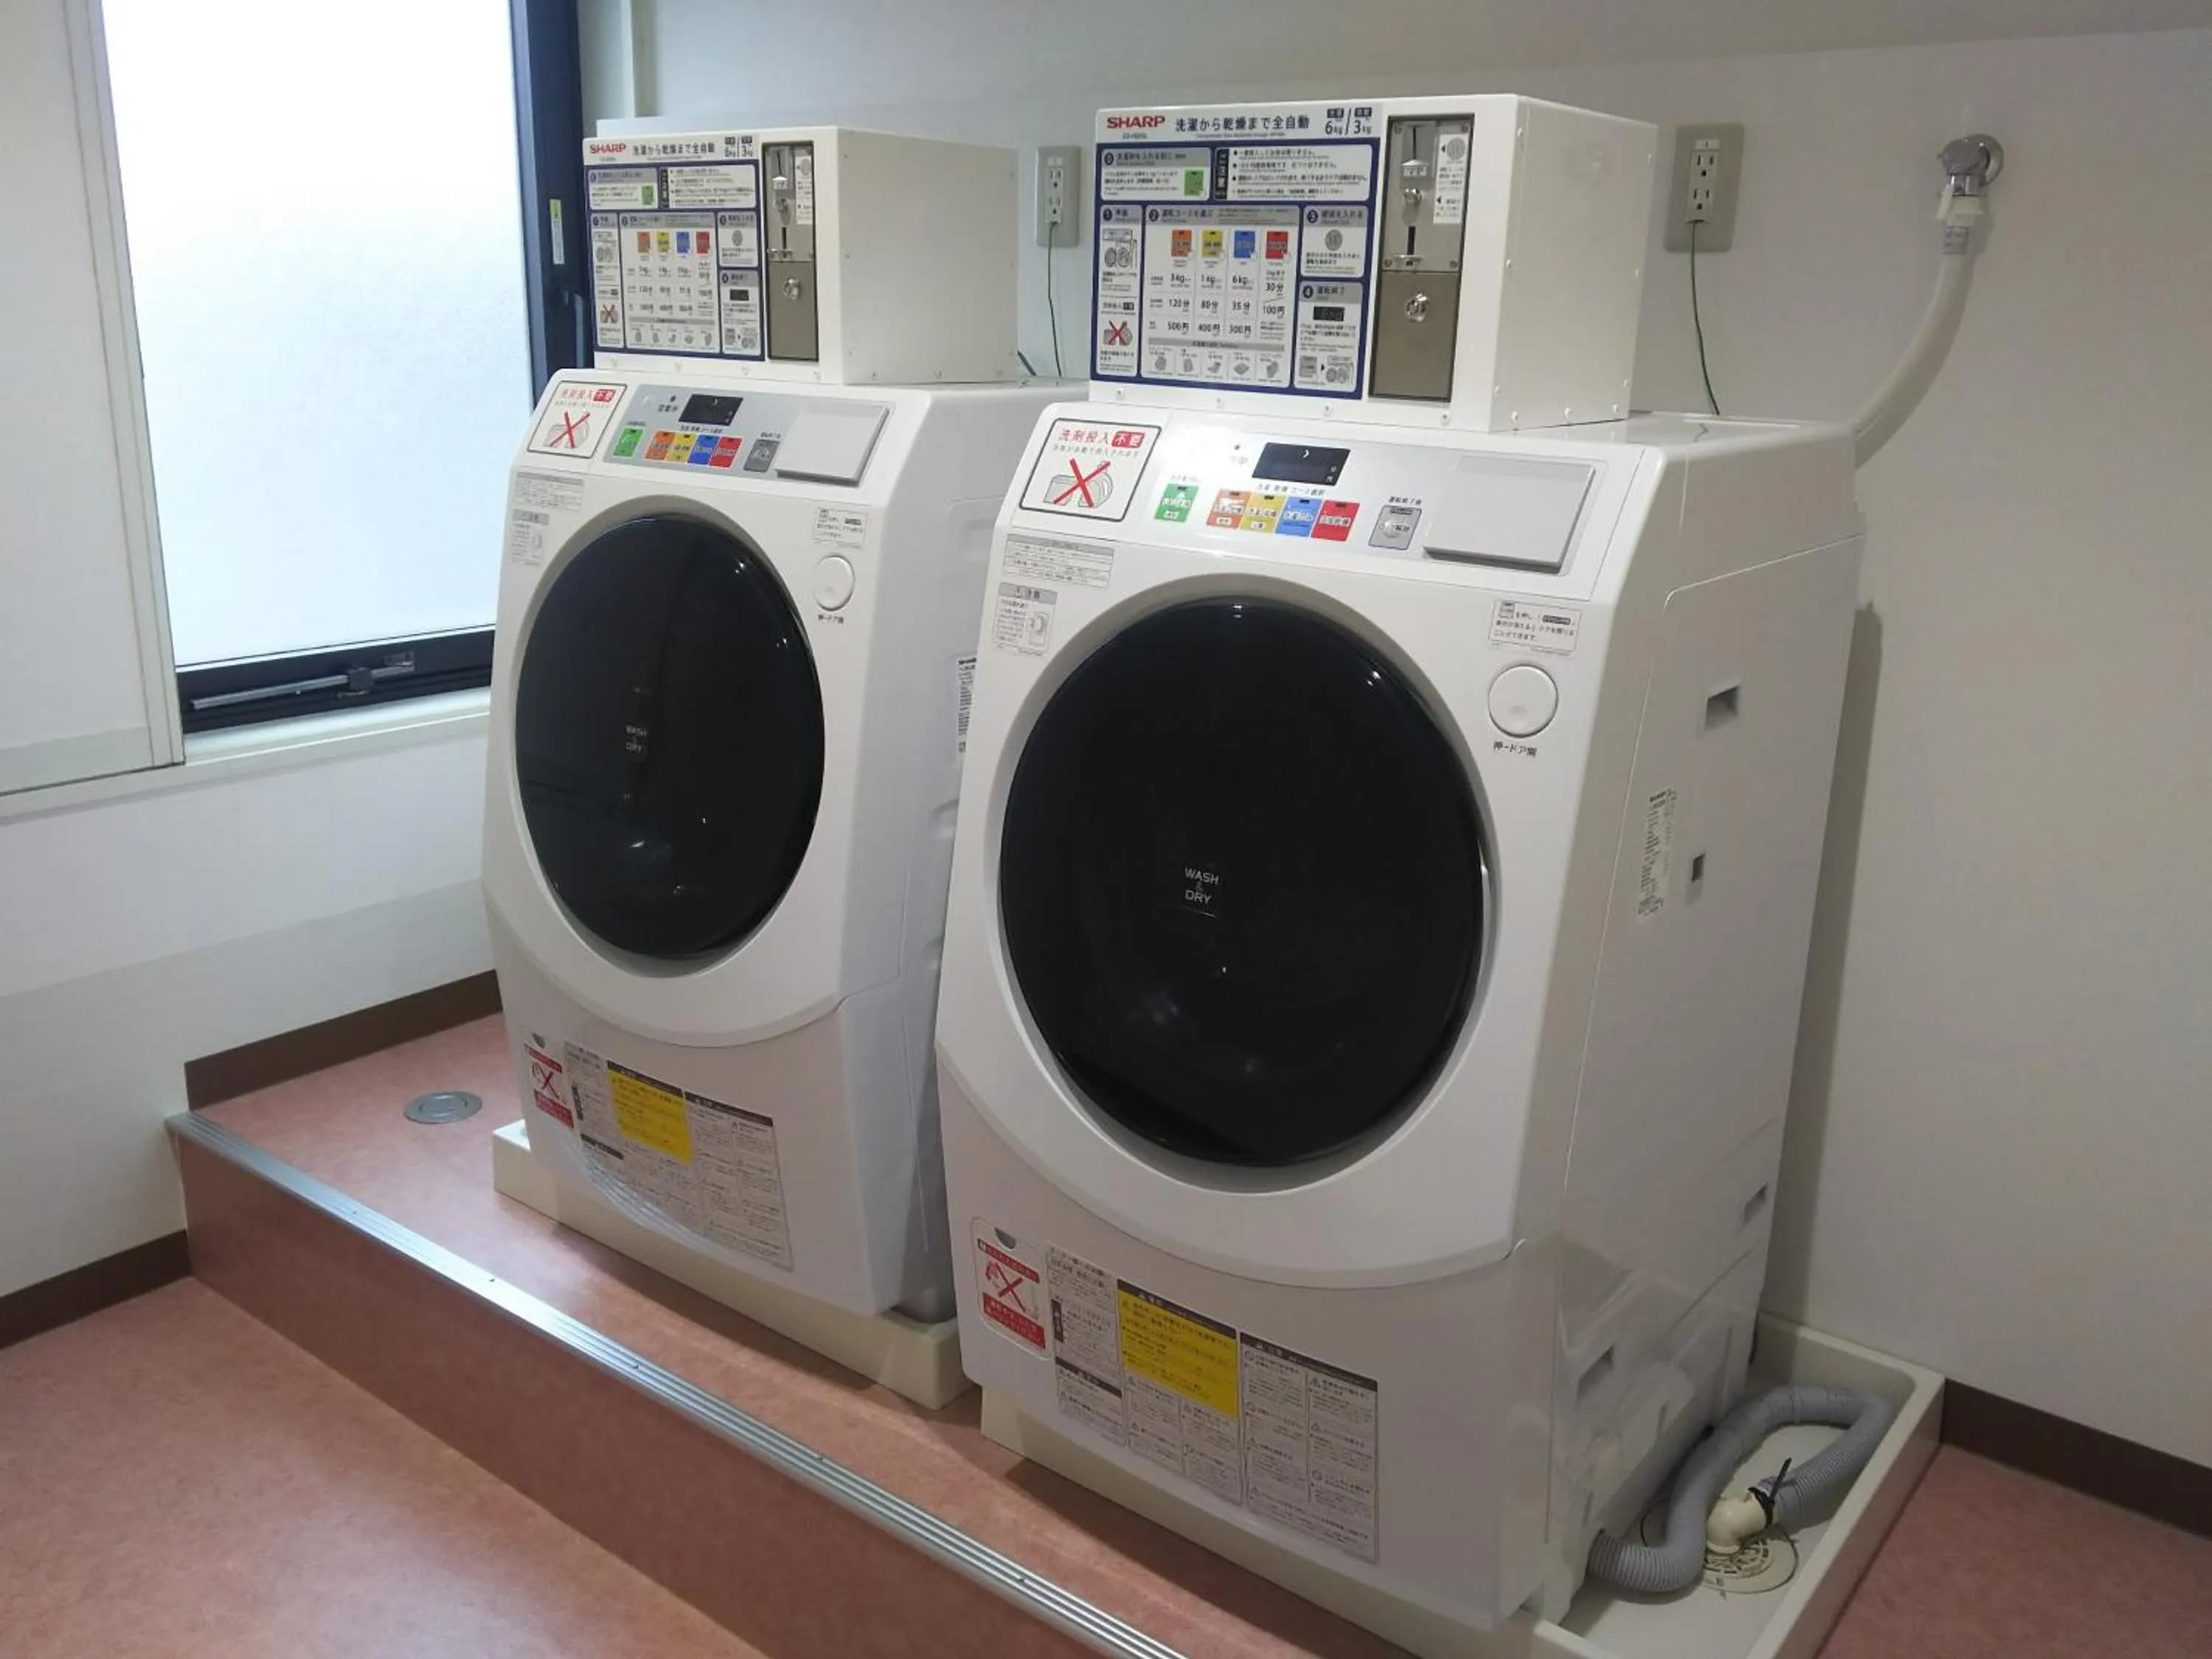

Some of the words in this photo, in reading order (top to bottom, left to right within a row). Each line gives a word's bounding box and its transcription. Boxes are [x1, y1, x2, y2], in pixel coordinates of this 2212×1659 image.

[1107, 115, 1165, 129] SHARP
[1175, 115, 1310, 133] 洗濯から乾燥まで全自動
[590, 142, 627, 154] SHARP
[1185, 867, 1219, 885] WASH
[1185, 889, 1211, 905] DRY
